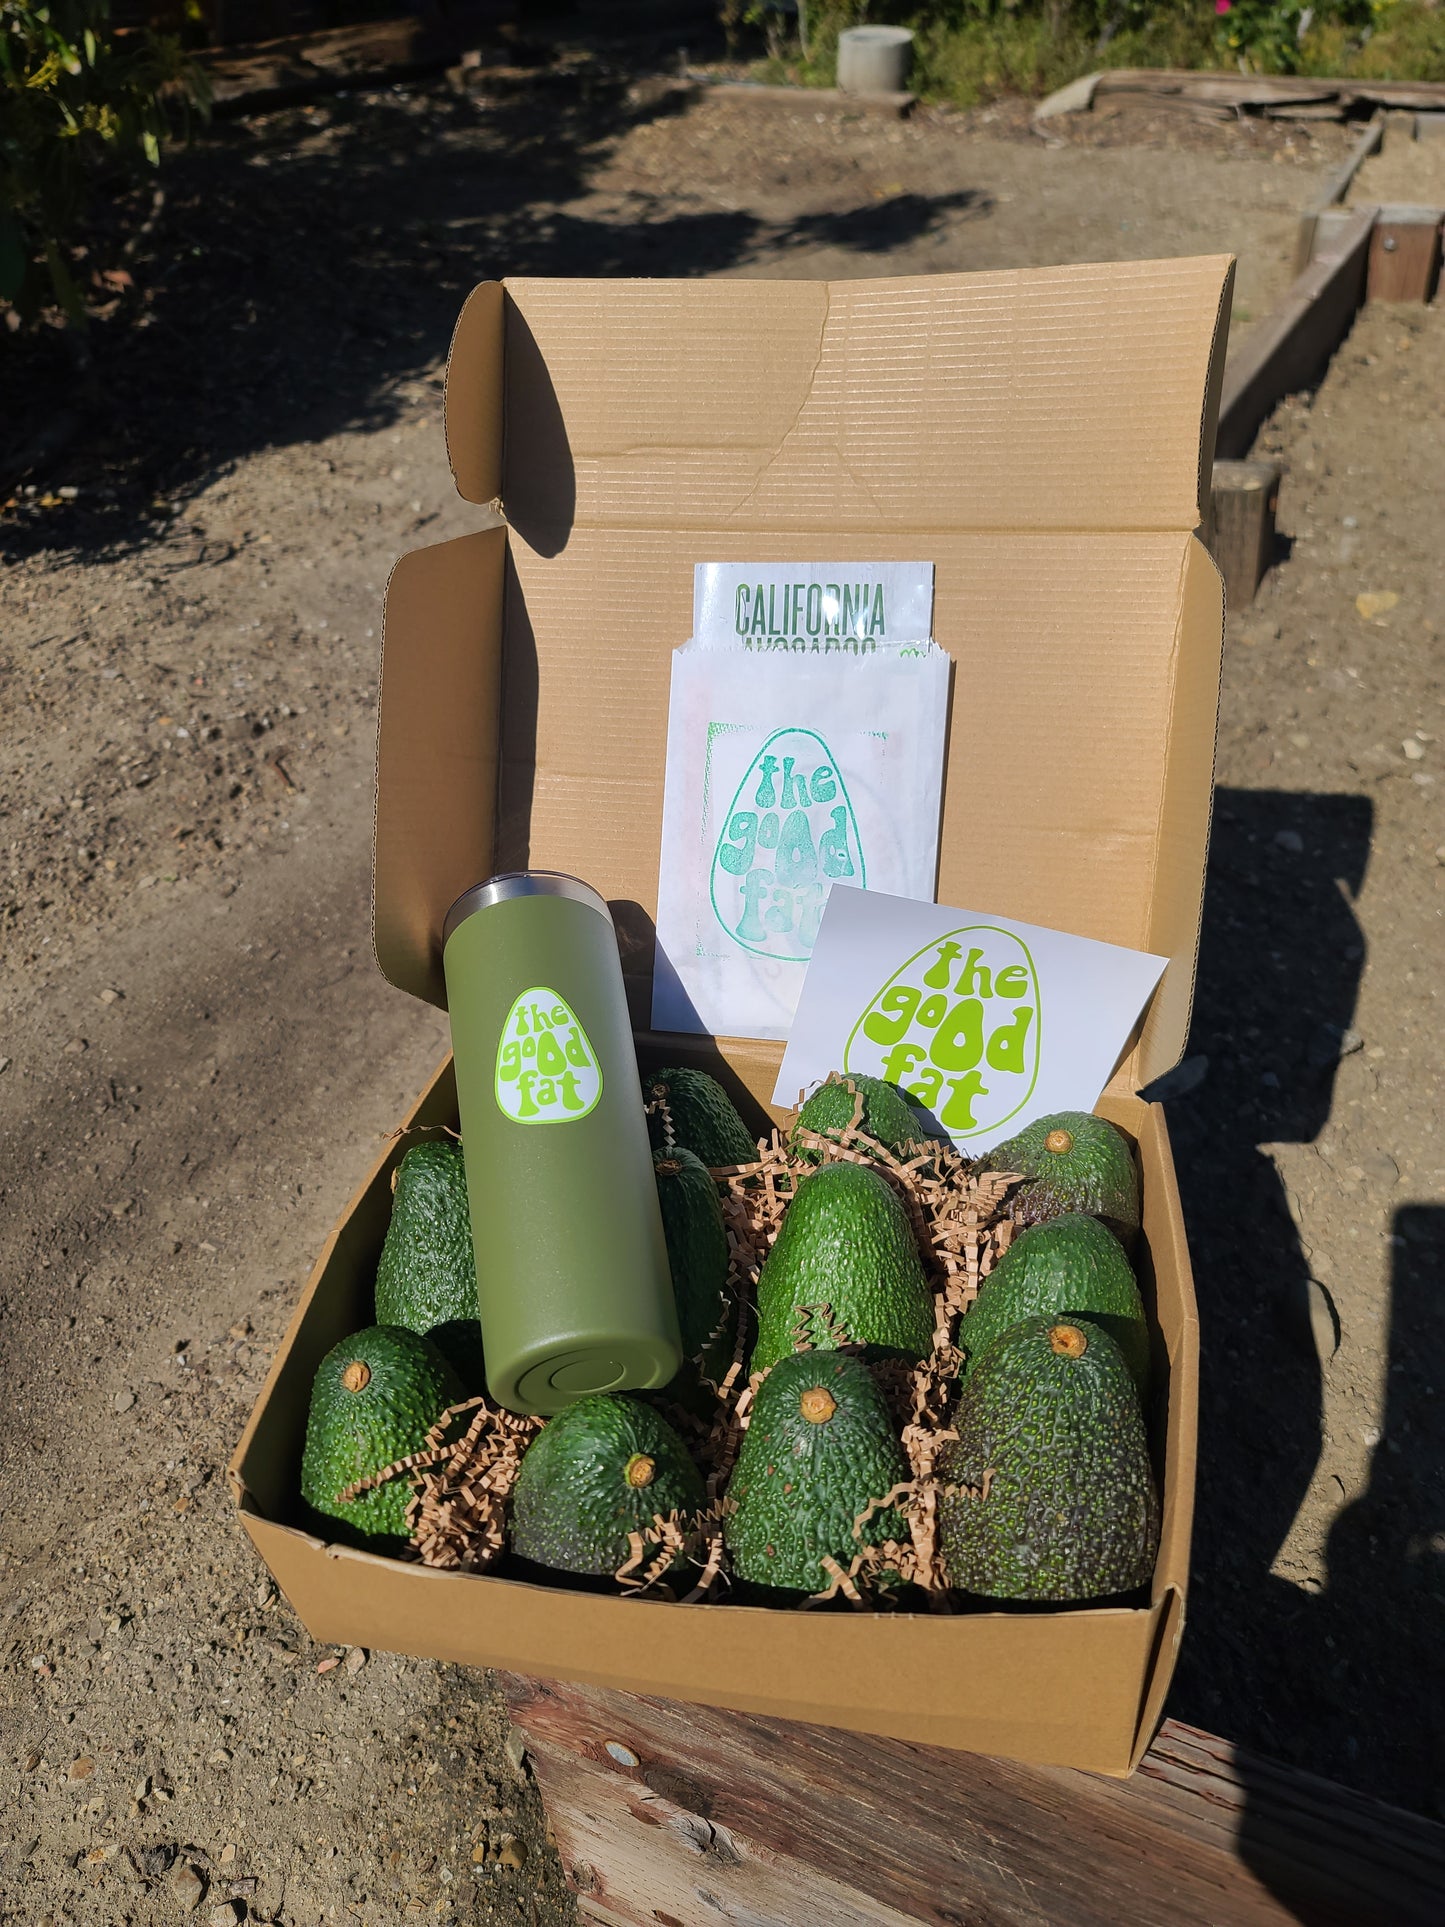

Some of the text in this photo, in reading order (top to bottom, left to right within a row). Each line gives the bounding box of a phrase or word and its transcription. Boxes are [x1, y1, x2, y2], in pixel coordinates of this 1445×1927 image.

[755, 755, 836, 809] the
[719, 806, 855, 889] good
[736, 868, 827, 949] fat
[923, 941, 1028, 998] the
[515, 1003, 569, 1036] the
[863, 985, 1034, 1074] good
[500, 1026, 592, 1082] good
[516, 1069, 585, 1117] fat
